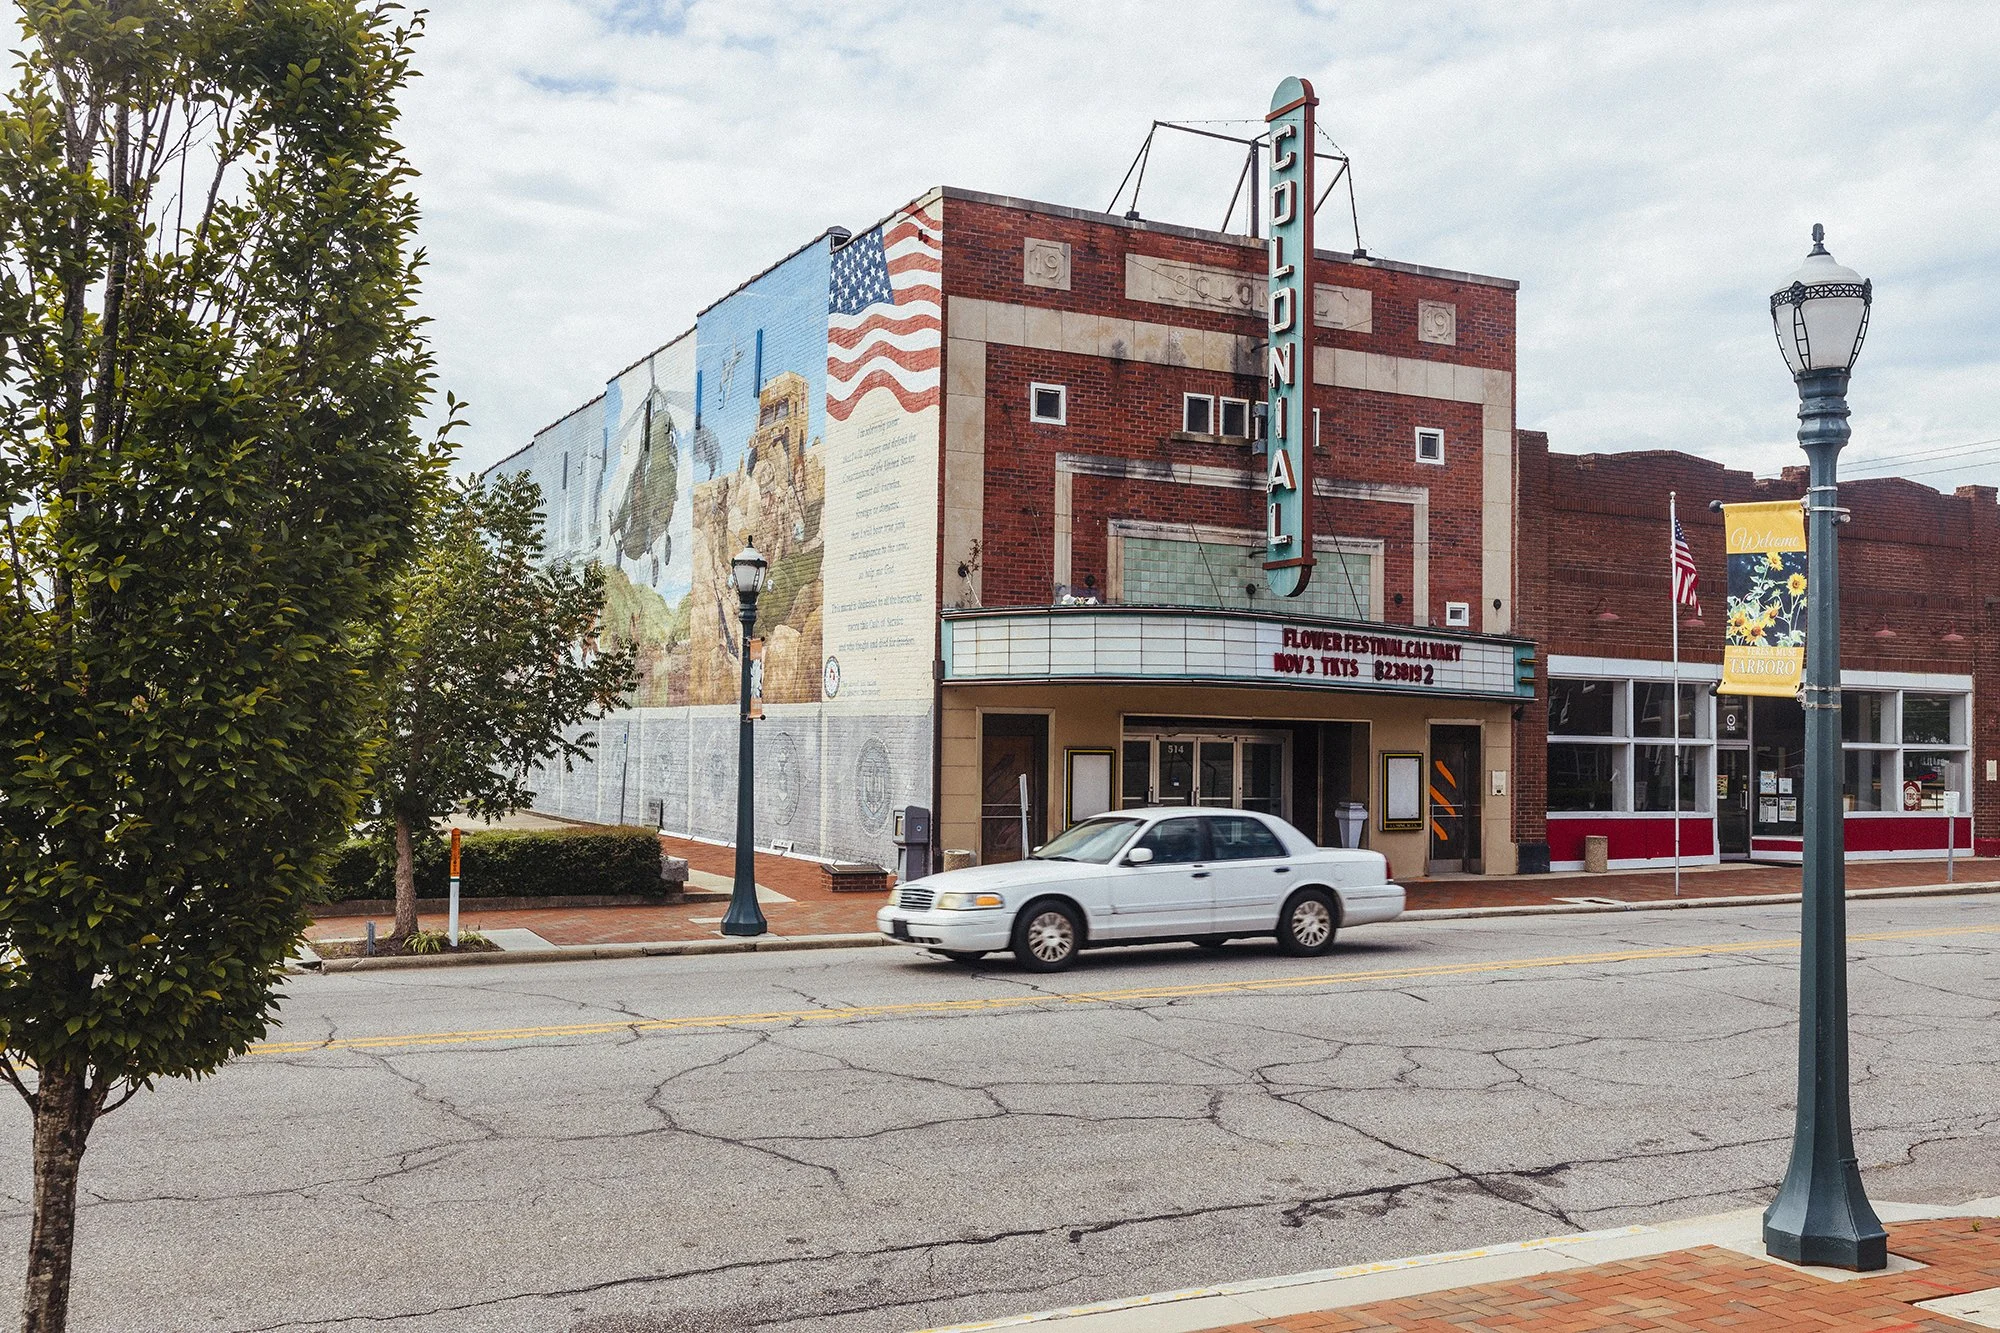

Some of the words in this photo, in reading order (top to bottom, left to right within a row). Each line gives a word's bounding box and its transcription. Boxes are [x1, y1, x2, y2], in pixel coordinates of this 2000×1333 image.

[1266, 122, 1296, 547] COLONIAL
[1730, 528, 1800, 551] Welcome
[1283, 628, 1342, 652] FLOWER
[1344, 633, 1405, 657] FESTIVAL
[1406, 640, 1463, 662] CALVARY
[1273, 652, 1304, 674] NOV
[1306, 656, 1315, 674] 3
[1321, 657, 1360, 677] TKTS
[1730, 657, 1796, 675] TARBORO
[1167, 744, 1184, 754] 514
